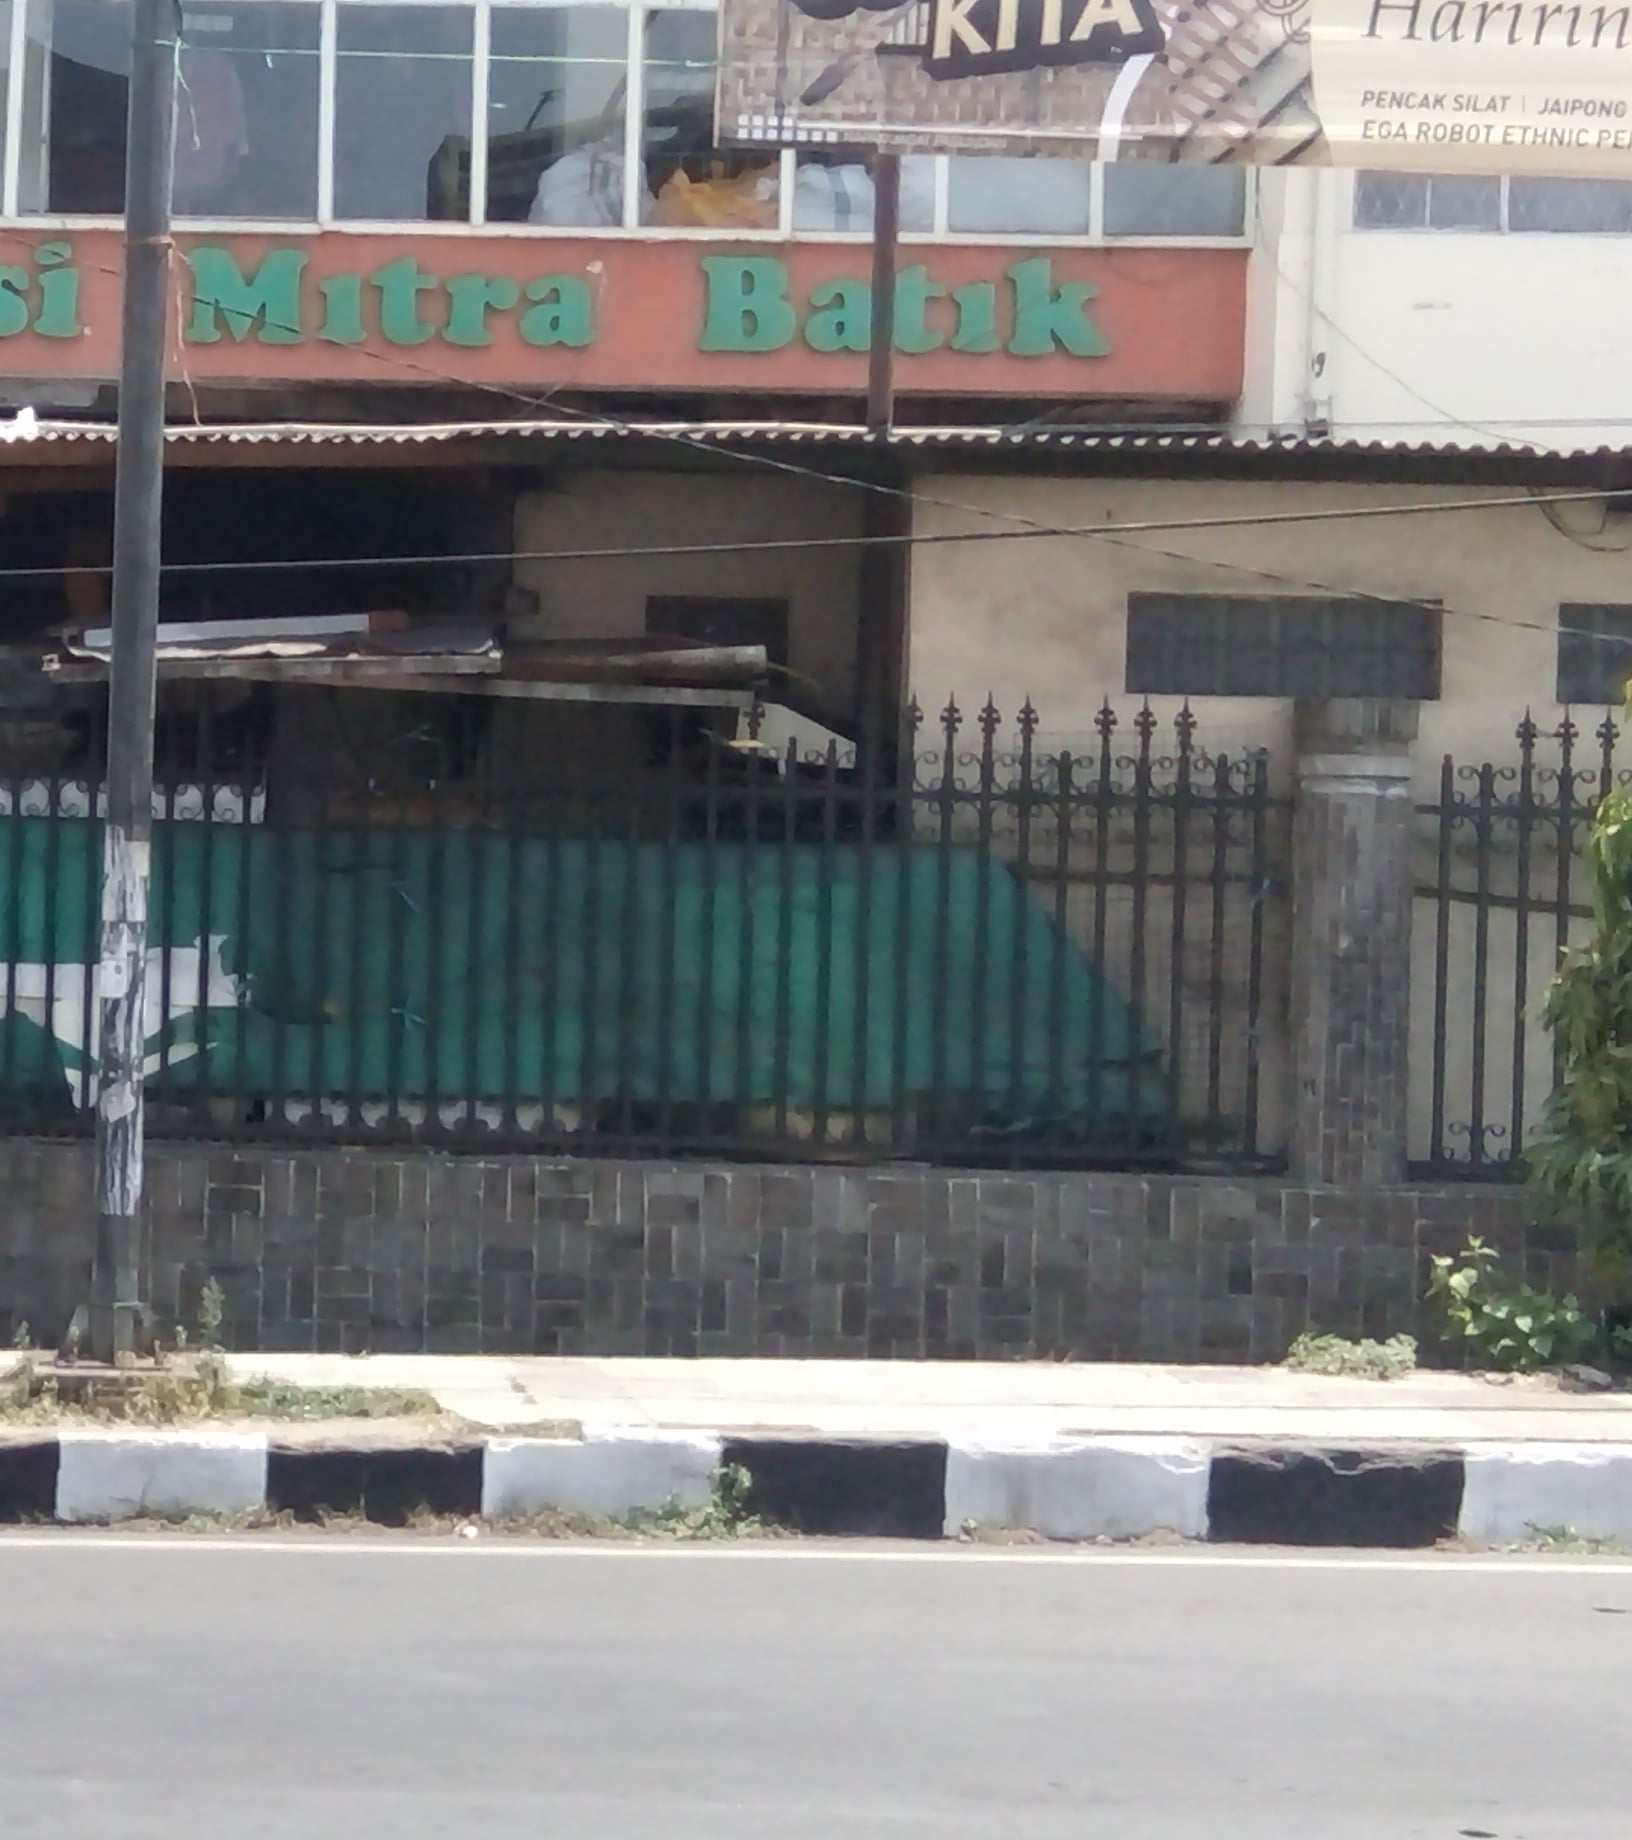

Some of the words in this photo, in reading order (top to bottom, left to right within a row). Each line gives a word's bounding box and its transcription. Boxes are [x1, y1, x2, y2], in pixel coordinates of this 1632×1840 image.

[1361, 90, 1447, 111] PENCAK
[1452, 94, 1511, 113] SILAT
[1361, 119, 1409, 141] EGA
[1415, 121, 1495, 145] ROBOT
[1501, 125, 1591, 148] ETHNIC
[186, 246, 597, 348] Mitra
[699, 253, 1111, 359] Batik
